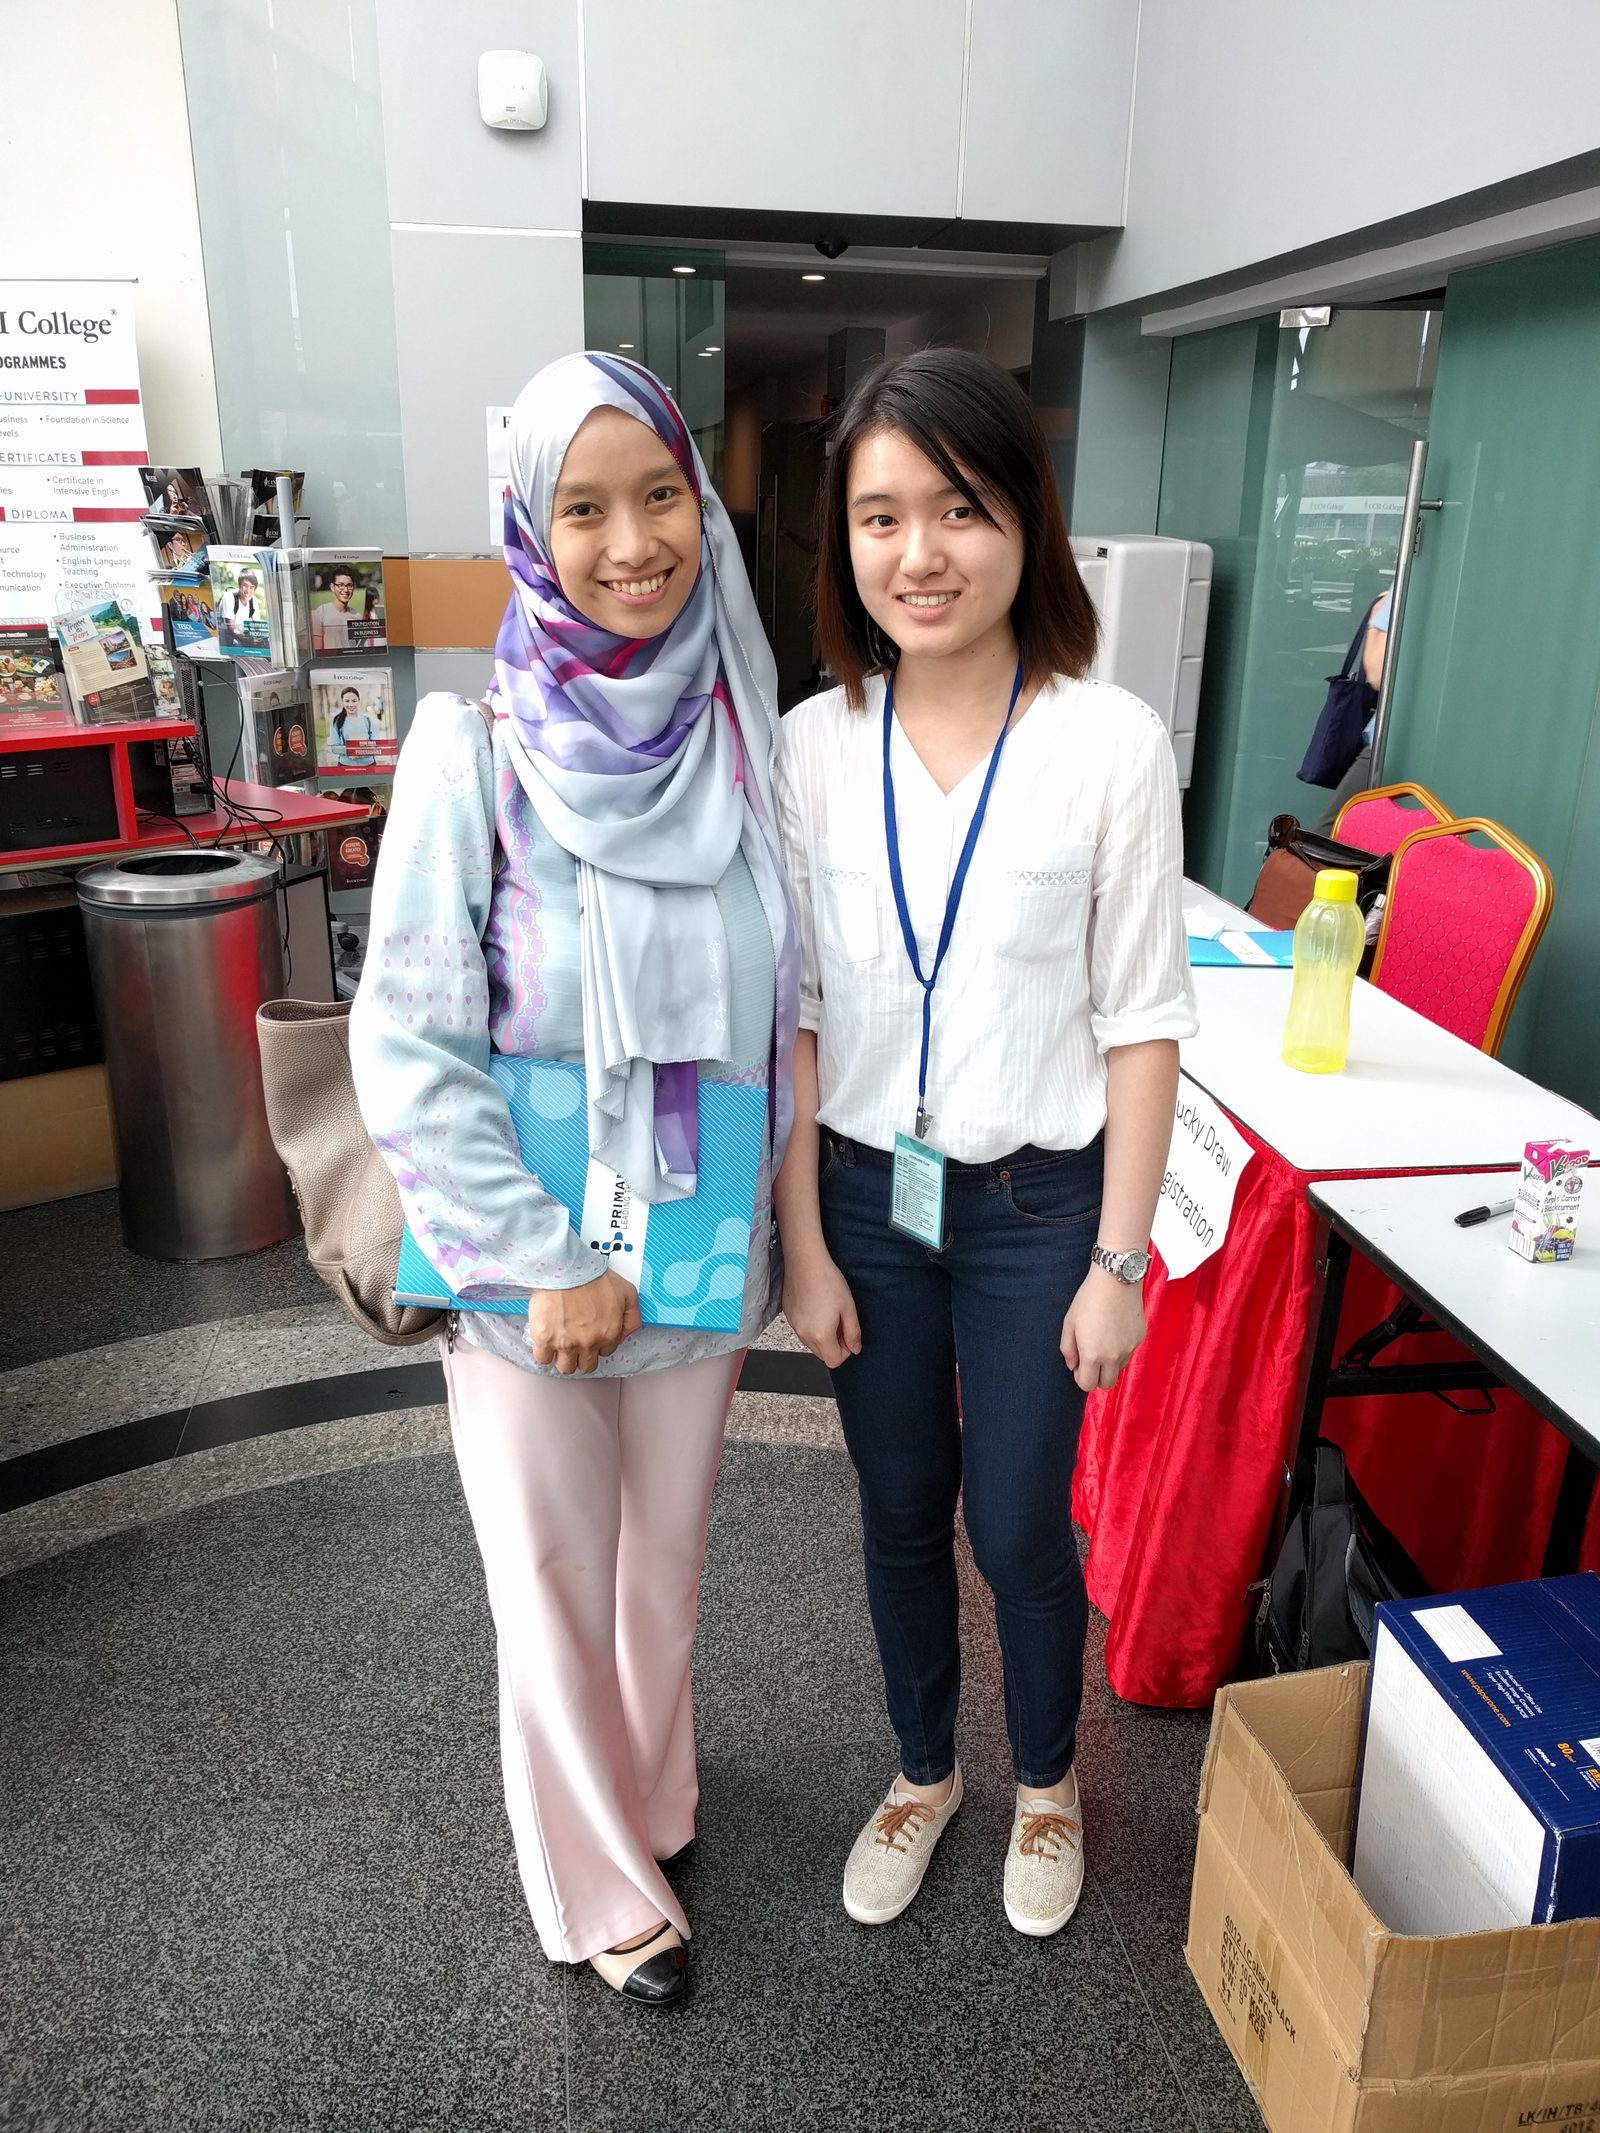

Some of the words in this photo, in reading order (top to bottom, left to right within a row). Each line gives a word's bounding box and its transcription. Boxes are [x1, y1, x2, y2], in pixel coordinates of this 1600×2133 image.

[18, 310, 112, 343] College
[45, 415, 90, 424] Foundation
[92, 415, 100, 424] in
[101, 416, 130, 424] Science
[52, 476, 94, 484] Certificate
[53, 487, 90, 495] Intensive
[91, 488, 121, 497] English
[11, 509, 68, 519] DIPLOMA
[59, 533, 96, 541] Business
[60, 543, 119, 552] Administration
[62, 557, 92, 566] English
[94, 557, 132, 567] Language
[2, 570, 46, 580] Technology
[62, 567, 99, 577] Teaching
[64, 581, 102, 589] Executive
[1176, 1100, 1205, 1144] ucky
[1204, 1126, 1232, 1177] Draw
[621, 1196, 631, 1230] LEADING
[1160, 1171, 1214, 1248] gistration
[1461, 1669, 1512, 1728] www.paperone.com
[1241, 1964, 1257, 1995] 1000
[1259, 1992, 1273, 2025] PCS
[1240, 1979, 1248, 1998] 10
[1250, 1996, 1266, 2030] KGS
[1271, 1990, 1297, 2044] BLACK
[1249, 2010, 1265, 2043] KGS
